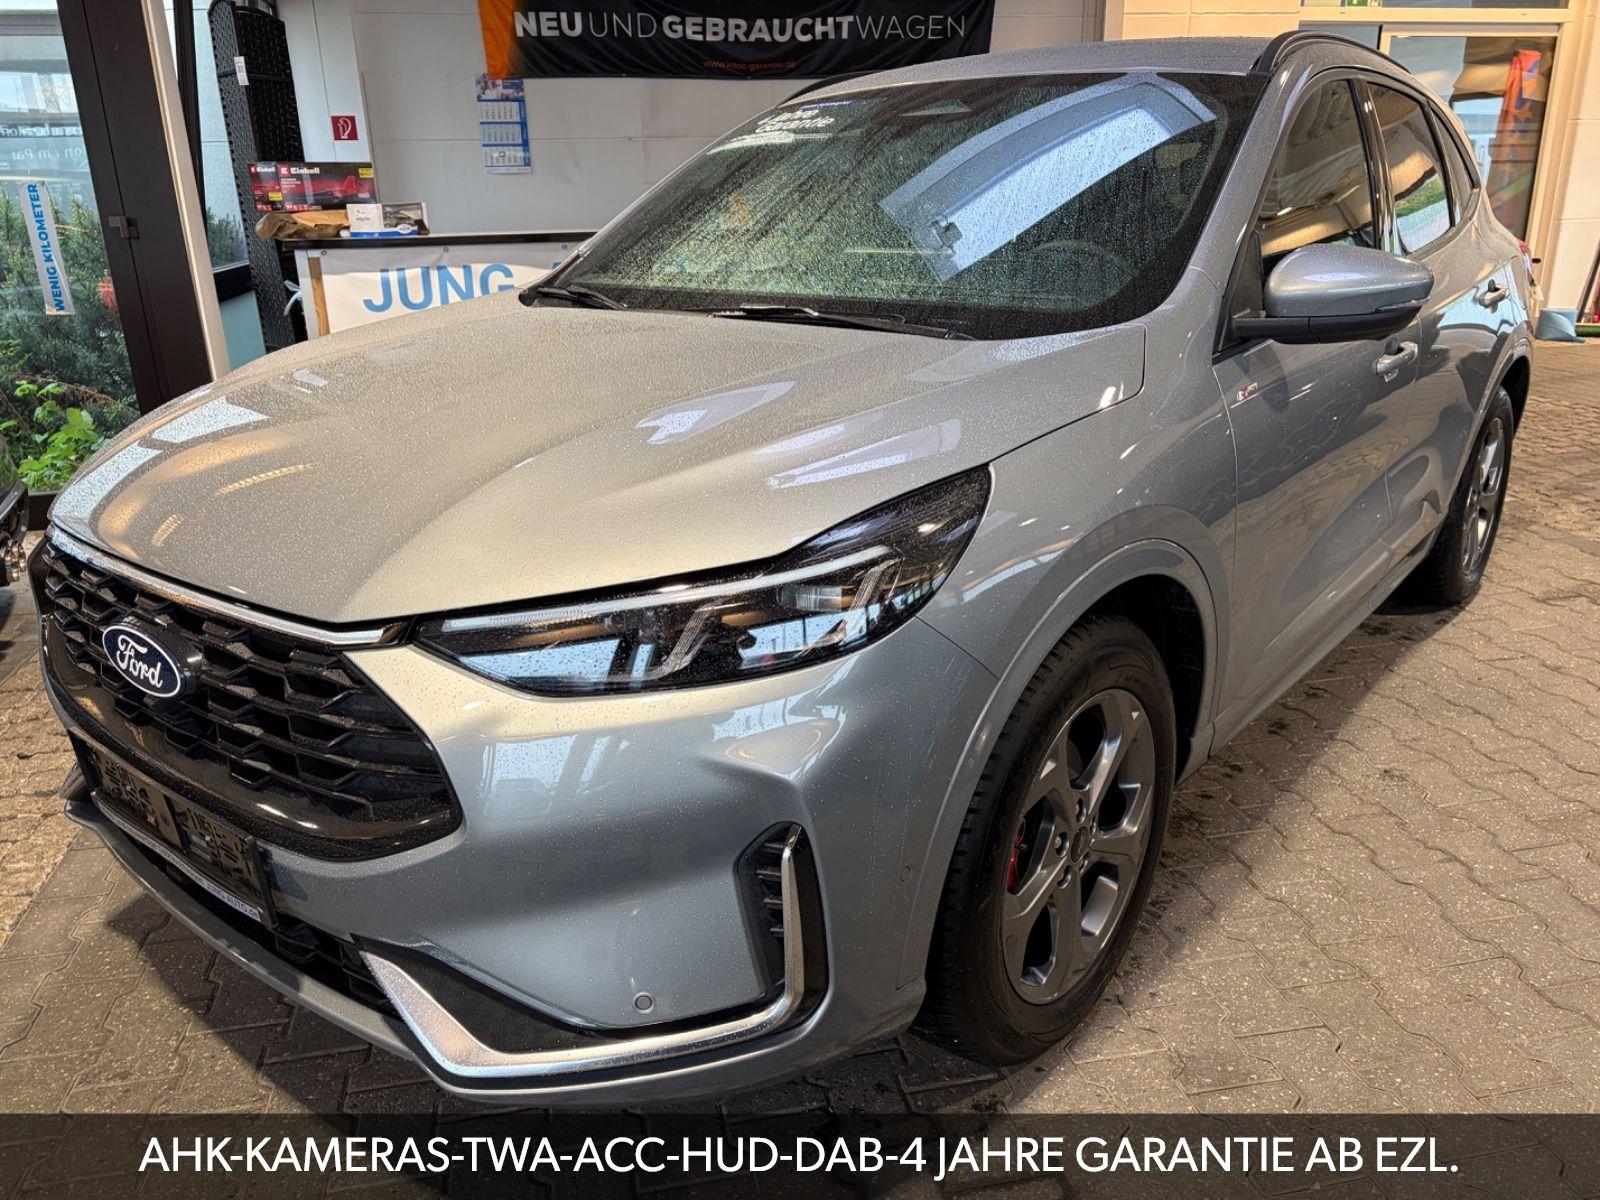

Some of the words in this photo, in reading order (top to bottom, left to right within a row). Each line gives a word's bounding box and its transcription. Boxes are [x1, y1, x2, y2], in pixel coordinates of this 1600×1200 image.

[513, 11, 583, 37] NEU
[588, 12, 657, 38] UND
[290, 166, 321, 175] Einhell
[27, 183, 54, 264] KILOMETER
[46, 266, 66, 313] WENIG
[362, 263, 515, 312] JUNG
[116, 634, 163, 689] Ford
